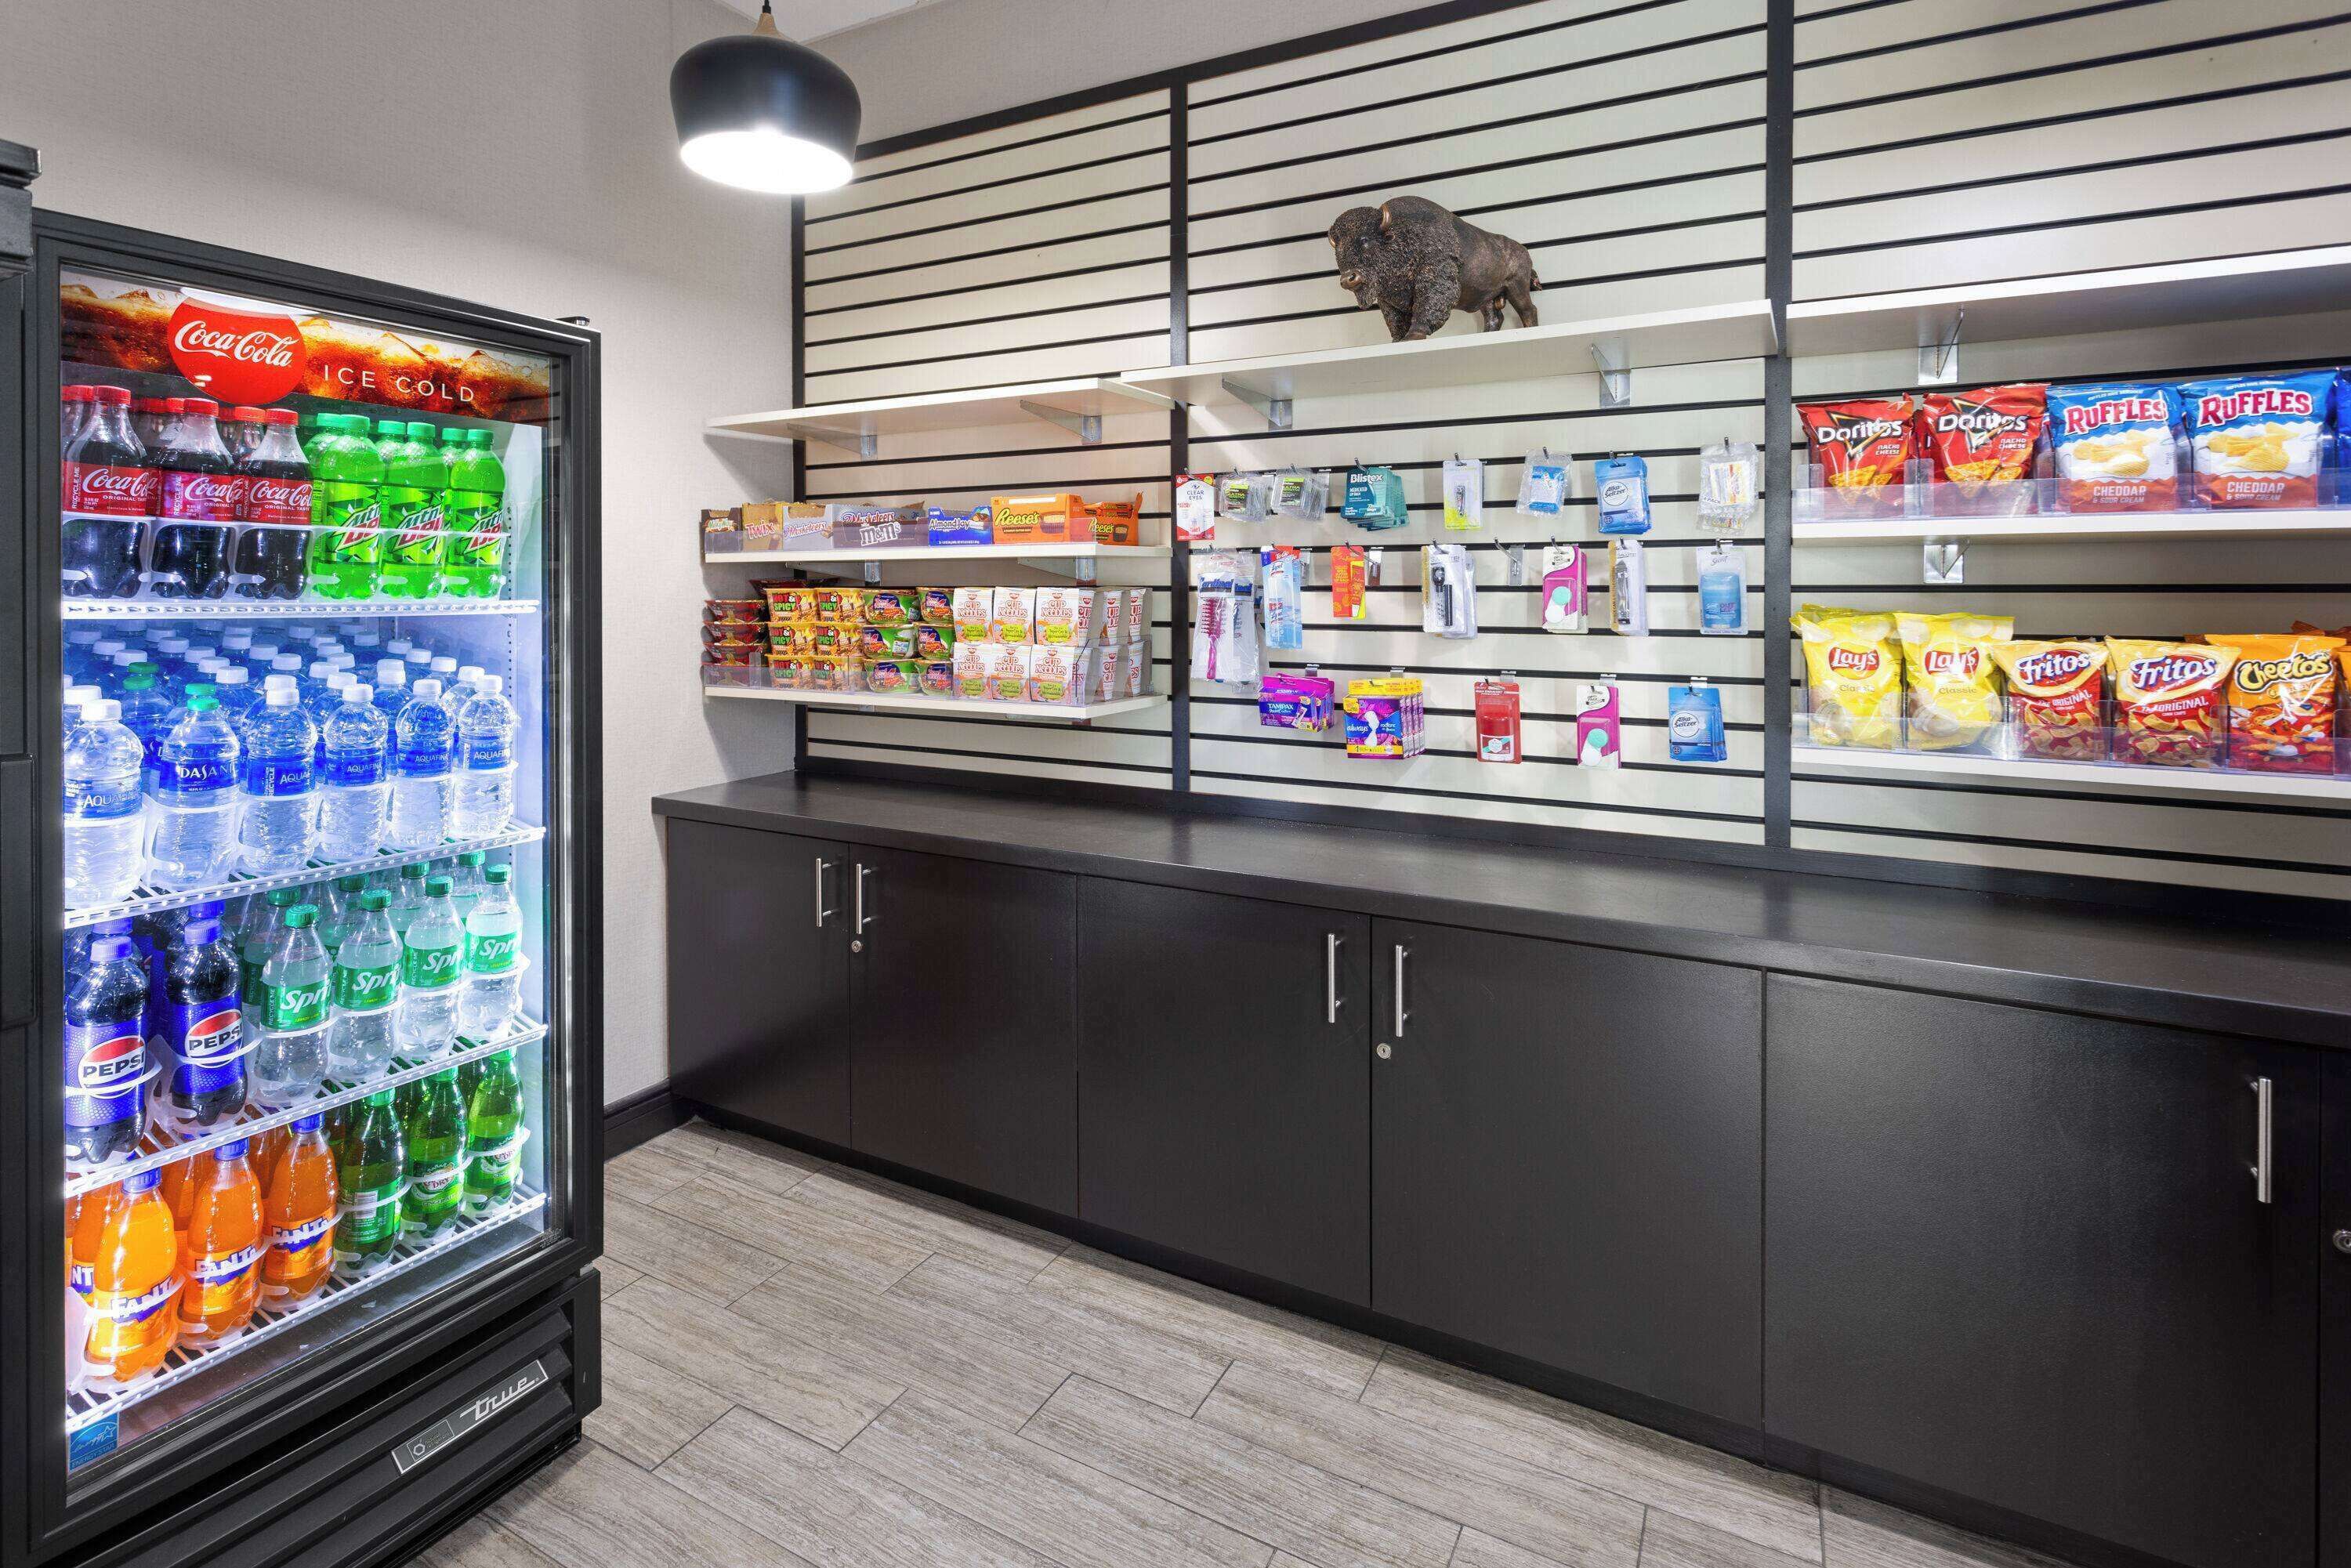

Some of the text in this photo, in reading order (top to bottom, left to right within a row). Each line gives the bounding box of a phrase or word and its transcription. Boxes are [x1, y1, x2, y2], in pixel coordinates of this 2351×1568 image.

[175, 320, 299, 368] Coca-Cola
[324, 364, 474, 403] ICE COLD
[2197, 389, 2313, 428] RUFFLES
[1938, 412, 2030, 433] Doritos
[2065, 398, 2168, 436] RUFFLES
[1818, 417, 1903, 444] Doritos
[1350, 473, 1384, 484] Blistex
[1605, 489, 1626, 498] Seltzer
[2094, 486, 2146, 497] CHEDDAR
[2227, 482, 2285, 494] CHEDDAR
[853, 512, 895, 523] Musketeers
[789, 522, 826, 538] Musketeers
[929, 518, 970, 531] Almond Joy
[773, 593, 795, 603] HOT &
[831, 593, 837, 602] &
[774, 603, 796, 611] SPICY
[964, 601, 980, 610] CUP
[1005, 600, 1022, 610] CUP
[1048, 600, 1067, 610] CUP
[958, 608, 987, 617] NOODLES
[998, 608, 1028, 617] NOODLES
[1041, 608, 1073, 617] NOODLES
[784, 628, 790, 636] &
[964, 656, 980, 664] CUP
[1002, 656, 1019, 664] CUP
[1043, 657, 1061, 666] CUP
[1831, 648, 1878, 672] Lay's
[958, 662, 985, 672] NOODLES
[994, 663, 1025, 674] NOODLES
[1034, 664, 1067, 675] NOODLES
[2016, 652, 2092, 686] Fritos
[2130, 655, 2216, 690] Fritos
[2238, 654, 2331, 690] Cheetos
[2052, 690, 2093, 707] ORIGINAL
[2158, 696, 2209, 713] ORIGINAL
[1347, 724, 1368, 733] always
